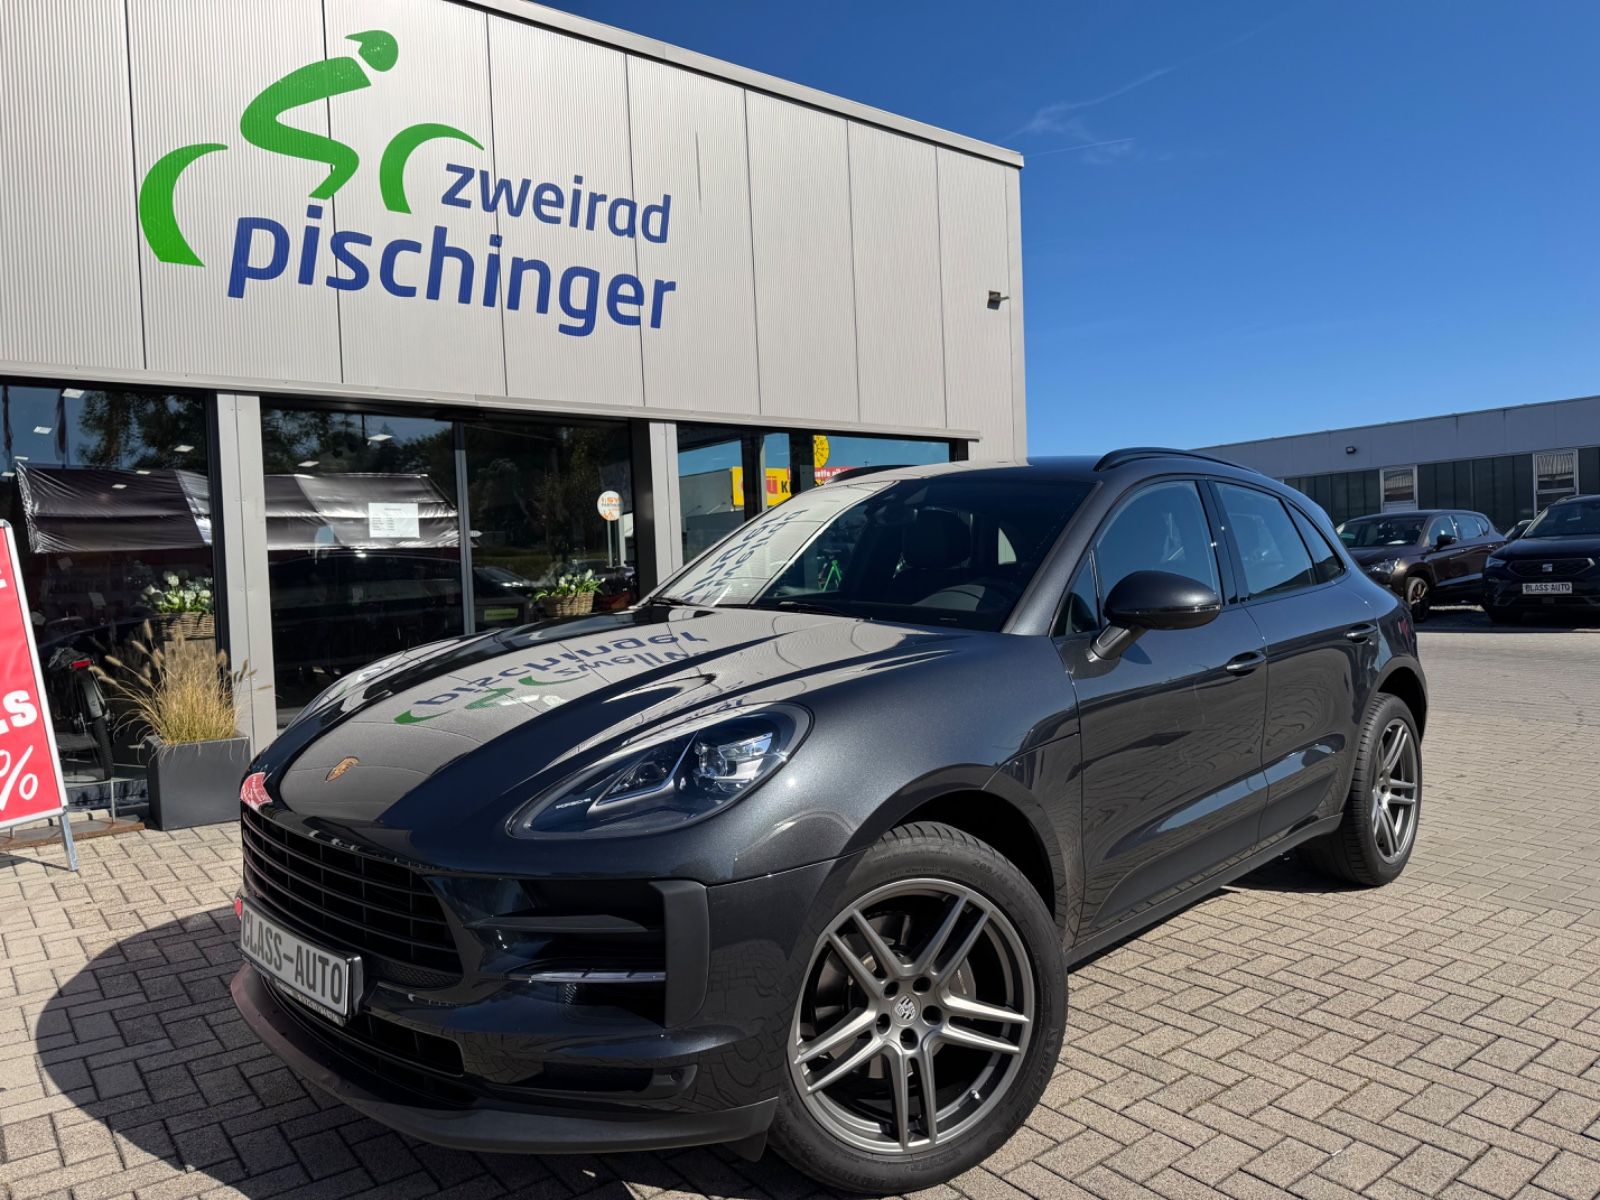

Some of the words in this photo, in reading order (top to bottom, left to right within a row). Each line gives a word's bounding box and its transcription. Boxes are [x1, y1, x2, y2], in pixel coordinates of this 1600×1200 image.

[441, 163, 671, 243] zweirad
[227, 204, 676, 337] pischinger
[242, 910, 343, 1005] CLASS-AUTO
